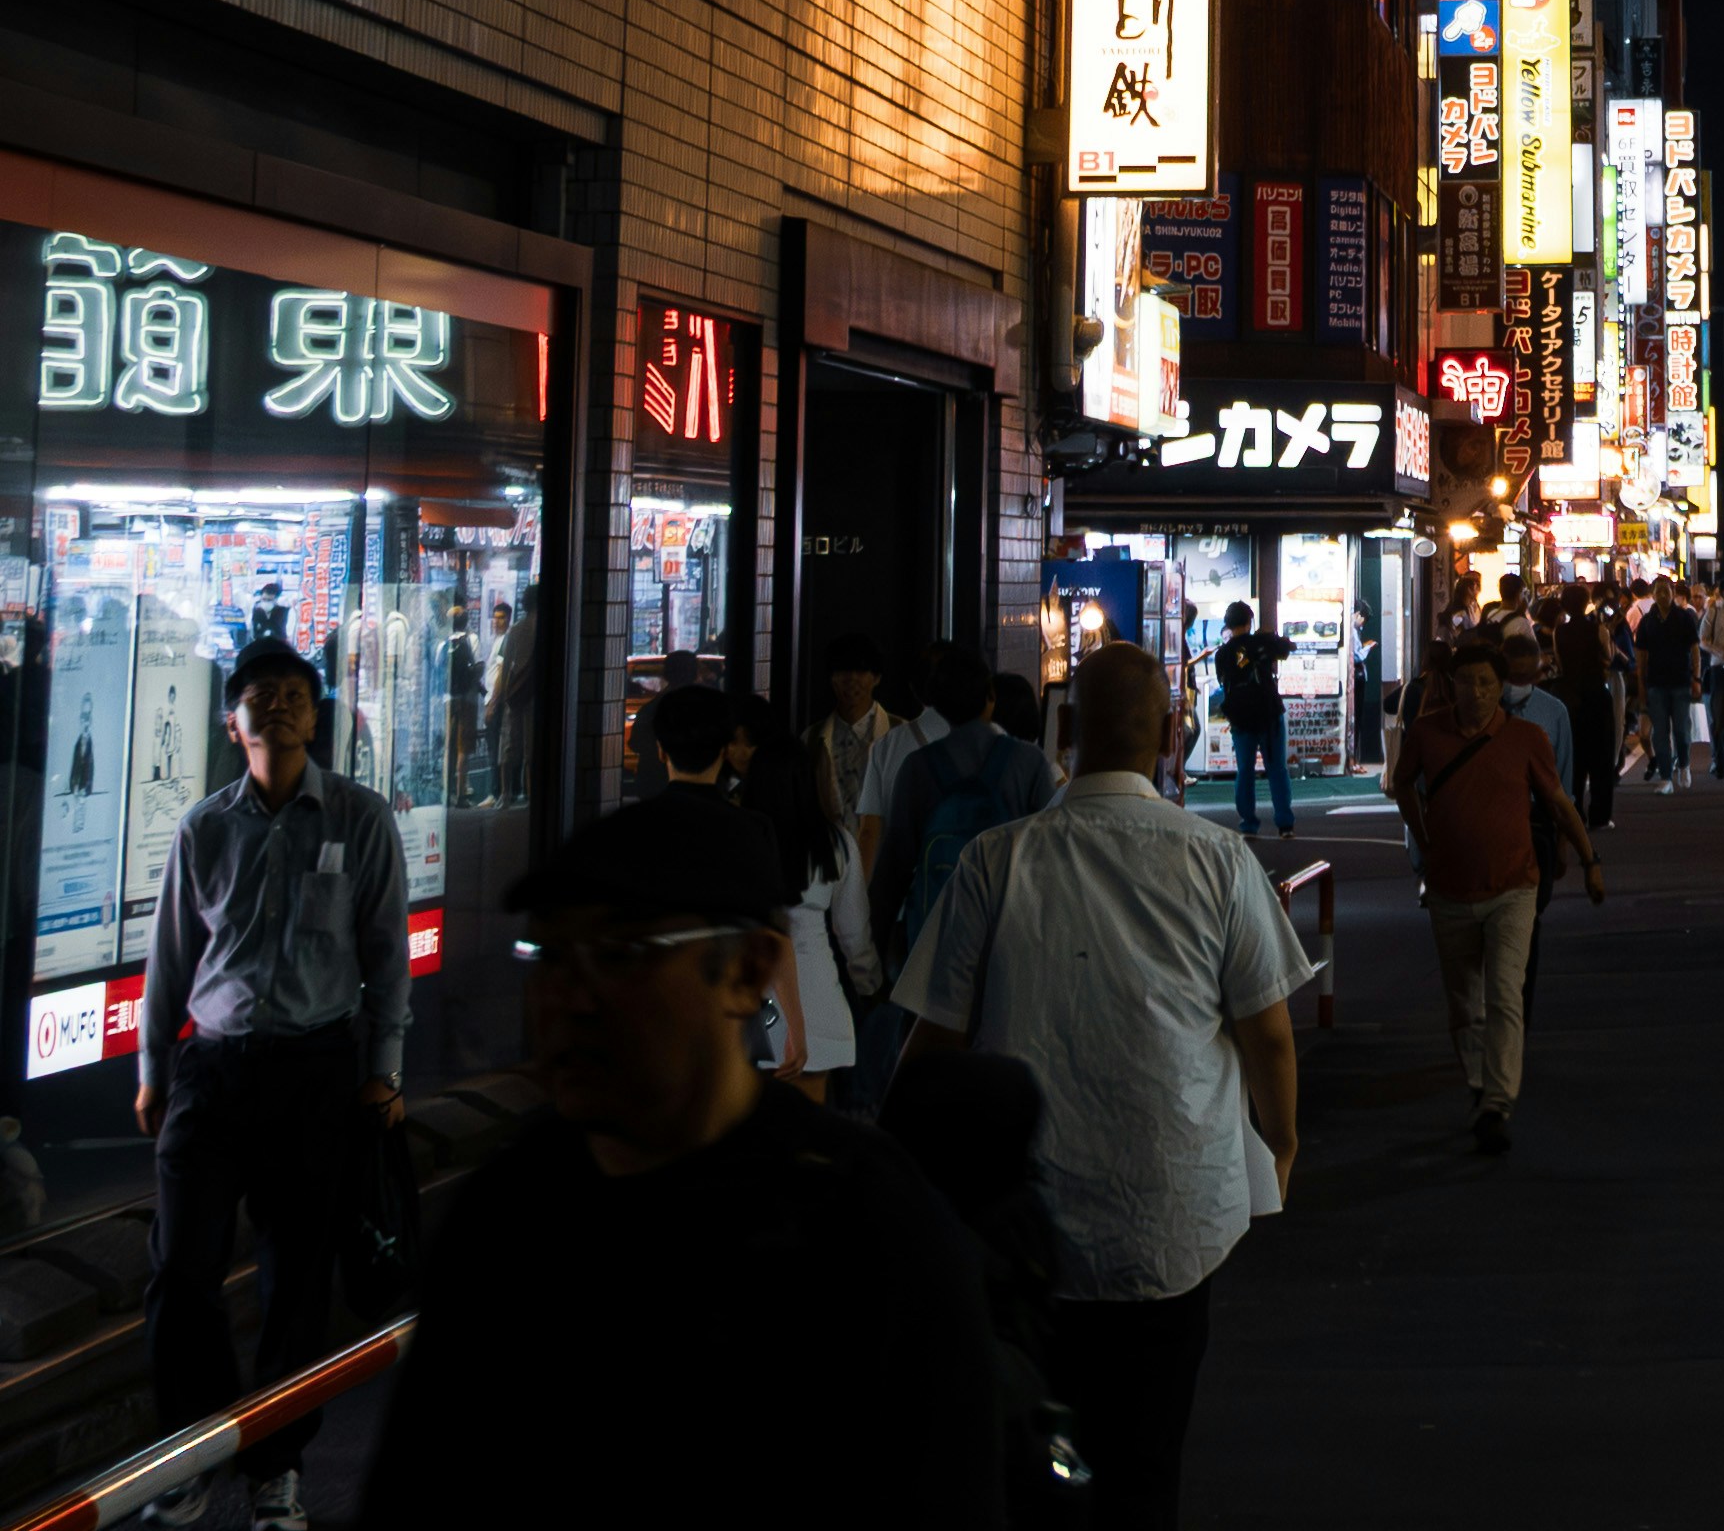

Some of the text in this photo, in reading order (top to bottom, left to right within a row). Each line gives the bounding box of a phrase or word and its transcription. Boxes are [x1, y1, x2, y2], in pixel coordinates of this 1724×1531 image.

[1472, 30, 1495, 50] 2F
[1103, 61, 1161, 128] 鉄
[1469, 62, 1499, 166] ヨドバシ
[1078, 151, 1115, 172] B1
[1441, 97, 1468, 174] カメラ
[1521, 58, 1542, 251] Yellow Submarine
[1257, 186, 1302, 201] パソコン!
[1330, 204, 1361, 215] Digital
[1618, 155, 1639, 294] 買取センター
[1664, 111, 1698, 310] ヨドバシカメラ
[1267, 206, 1290, 325] 高価買取
[1329, 290, 1342, 300] PC
[1541, 270, 1565, 459] ケータイアクセサリー館
[1667, 325, 1698, 412] 時計館
[1057, 586, 1102, 597] SUORY
[59, 1009, 96, 1045] MUFG
